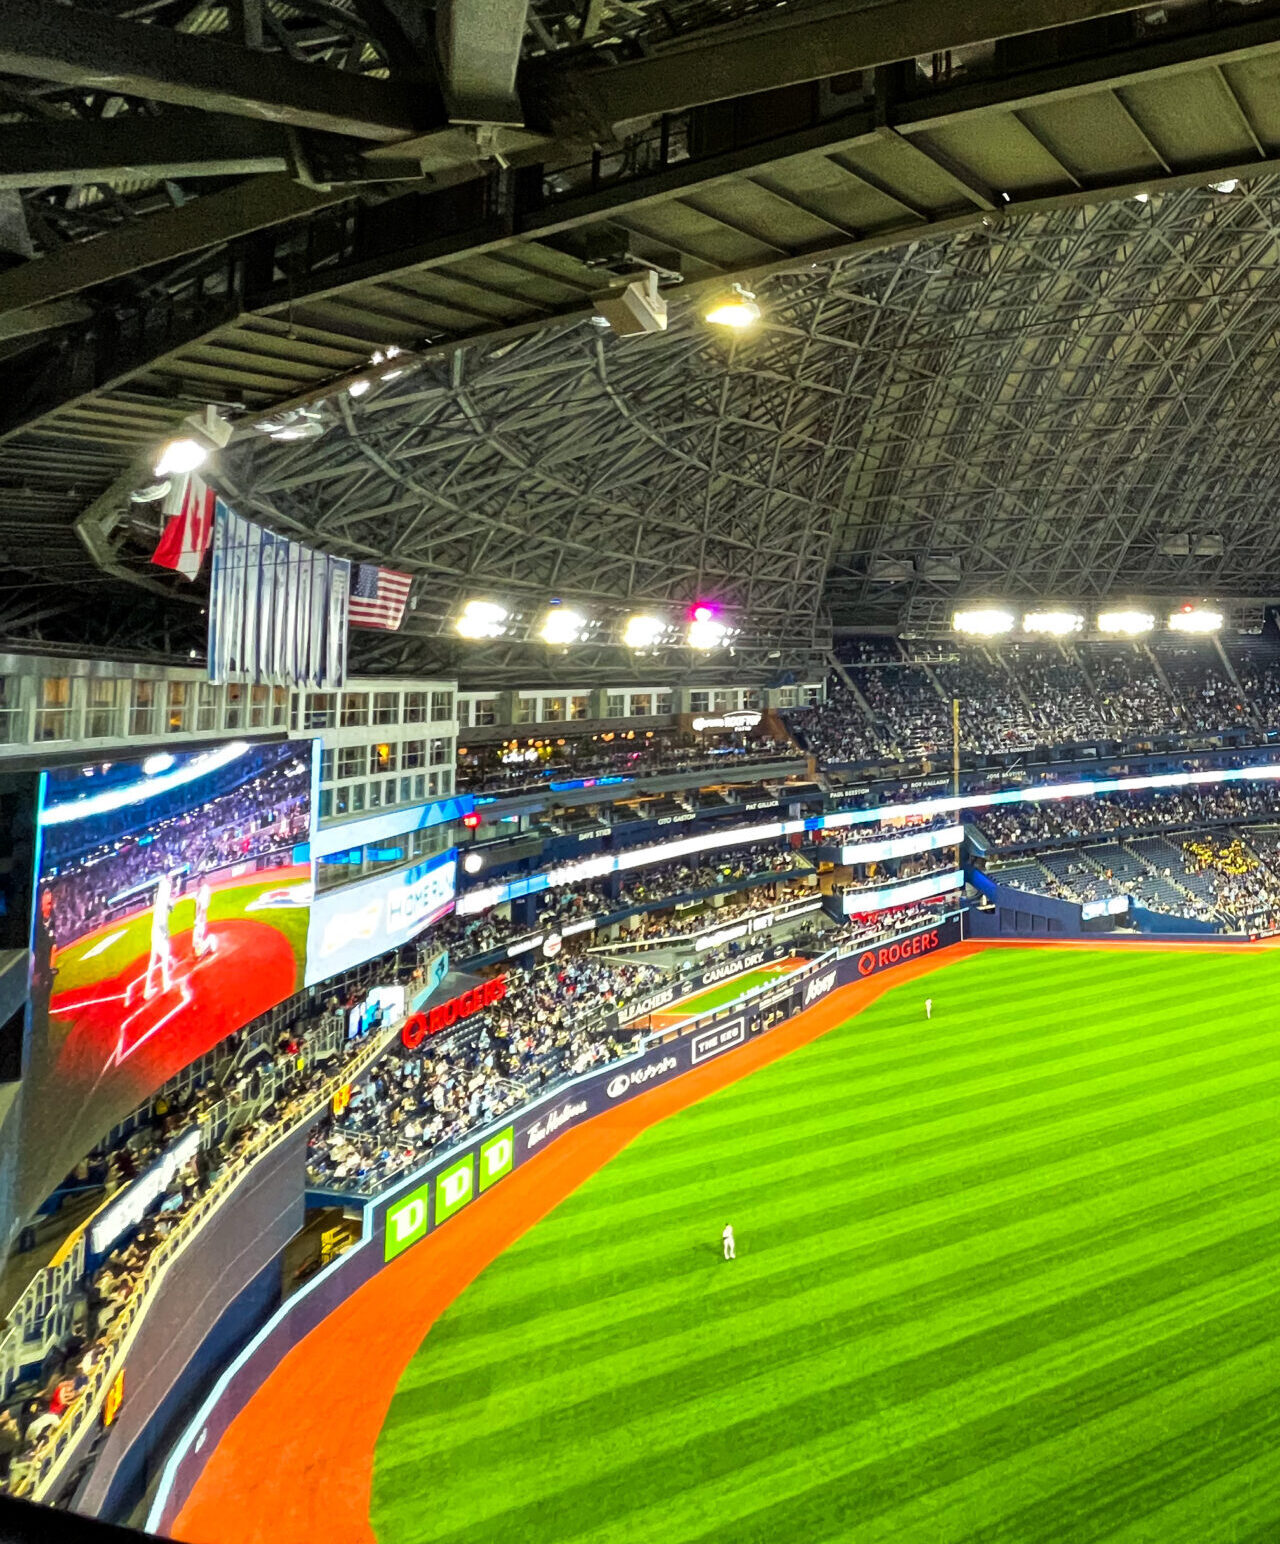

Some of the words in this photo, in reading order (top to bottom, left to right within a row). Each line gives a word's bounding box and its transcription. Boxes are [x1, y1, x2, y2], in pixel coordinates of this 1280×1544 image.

[878, 929, 939, 967] ROGERS
[702, 961, 743, 985] CANADA
[428, 973, 508, 1035] ROGERS
[630, 1056, 678, 1085] Kubota
[527, 1121, 547, 1149] Tim
[483, 1138, 511, 1176] TD
[440, 1166, 471, 1208] TD
[390, 1198, 425, 1242] TD
